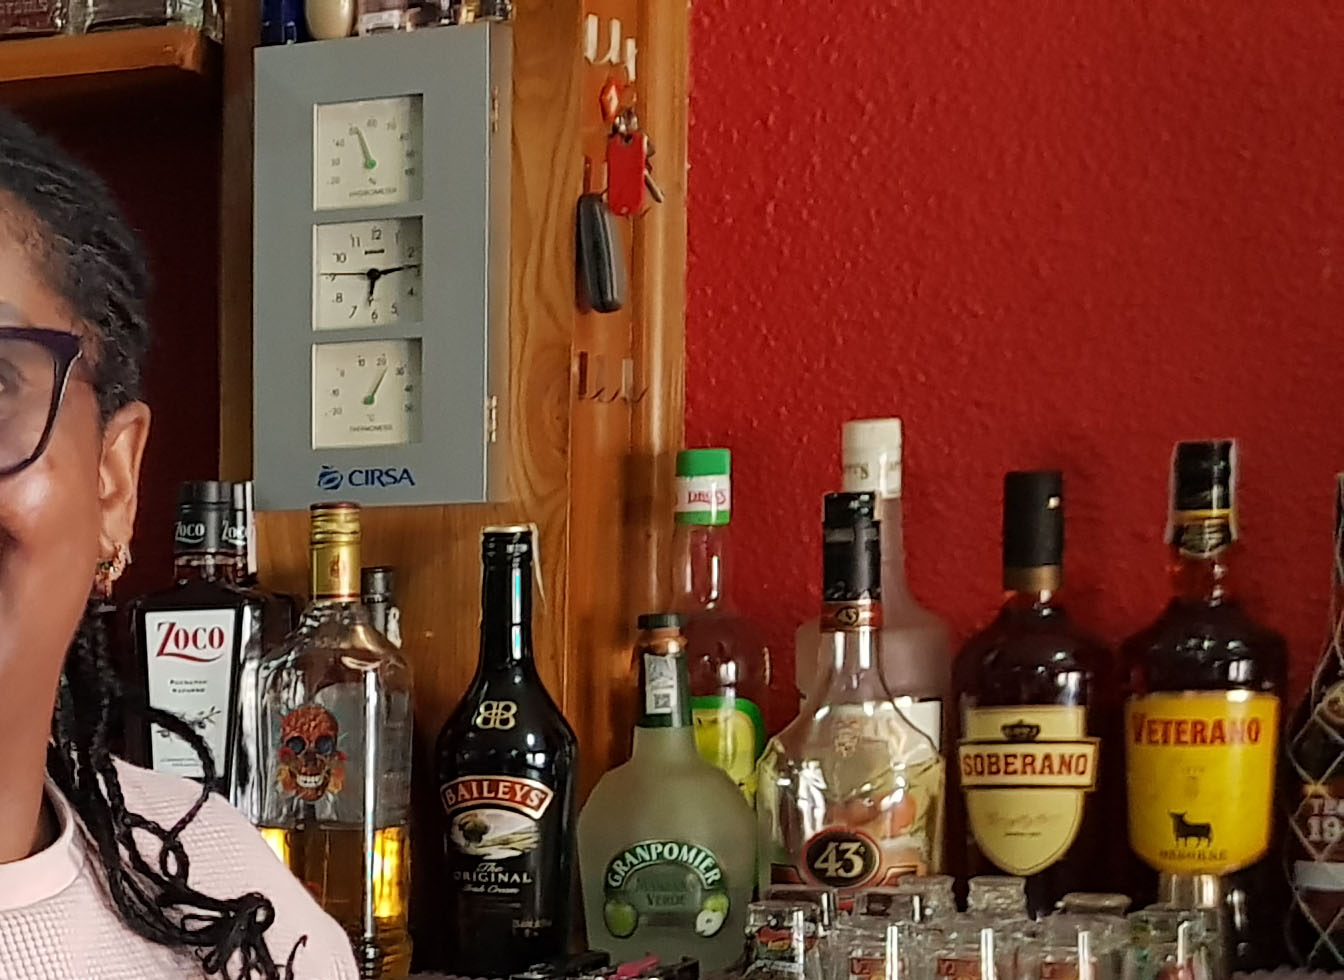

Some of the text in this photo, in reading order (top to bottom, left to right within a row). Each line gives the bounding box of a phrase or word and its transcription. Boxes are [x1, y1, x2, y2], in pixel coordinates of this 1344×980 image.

[370, 228, 383, 241] 12
[335, 291, 344, 304] 8
[348, 467, 416, 488] CIRSA
[1132, 712, 1262, 746] VETERANO
[963, 752, 1089, 777] SOBERANO
[445, 779, 546, 808] BAILEYS
[607, 842, 722, 888] GRANPOMIER
[813, 840, 864, 879] 43
[453, 870, 533, 885] ORIGINAL
